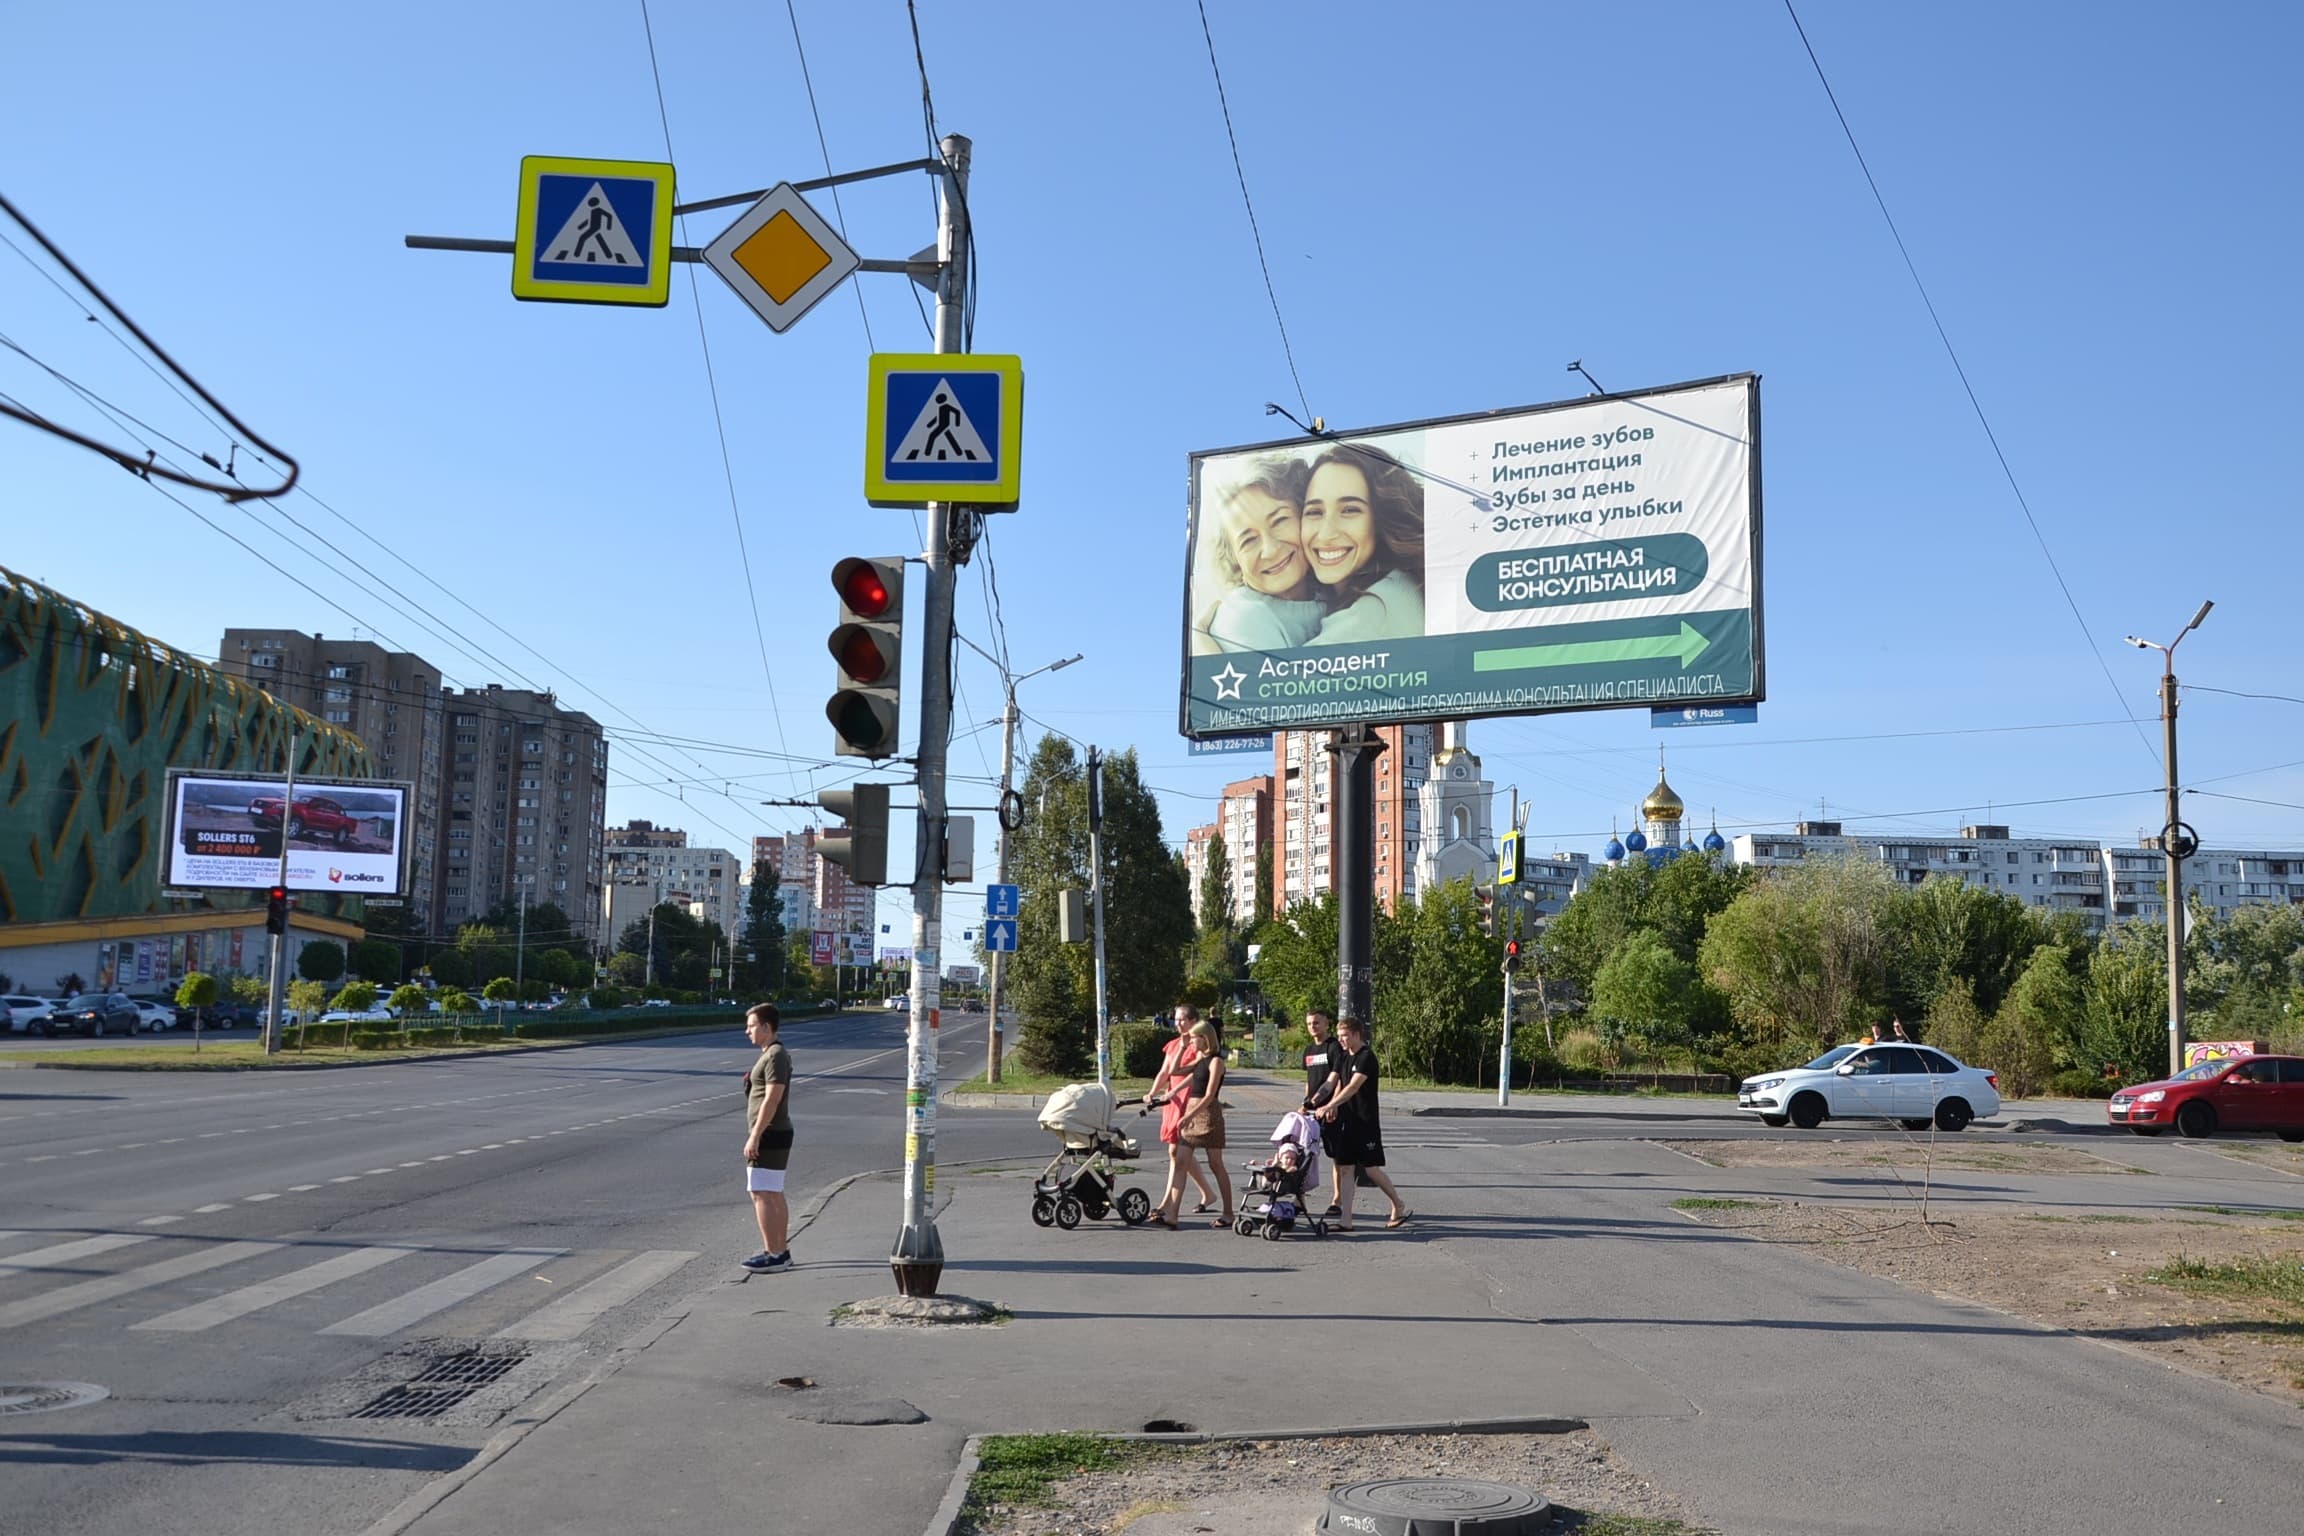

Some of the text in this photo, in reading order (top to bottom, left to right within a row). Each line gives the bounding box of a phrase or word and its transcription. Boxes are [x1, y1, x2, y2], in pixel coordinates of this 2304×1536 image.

[1492, 425, 1655, 459] Лечение зубов
[1493, 453, 1642, 482] Имплантация
[1492, 480, 1635, 511] Зубы за день
[1492, 498, 1683, 533] Эстетика улыбки
[1499, 547, 1644, 579] БЕСПЛАТНАЯ
[1499, 567, 1677, 601] КОНСУЛЬТАЦИЯ
[1258, 652, 1390, 679] Астродент
[1258, 670, 1428, 698] стоматология
[1209, 704, 1268, 729] ИМЕЮТСЯ
[1411, 687, 1503, 713] НЕОБХОДИМА
[1506, 680, 1614, 706] КОНСУЛЬТАЦИЯ
[1617, 673, 1725, 699] СПЕЦИАЛИСТА
[1700, 708, 1725, 718] Russ
[1194, 738, 1265, 752] 8 (863) 226-77-26
[197, 831, 256, 844] SOLLERS ST6
[344, 873, 385, 883] sollers
